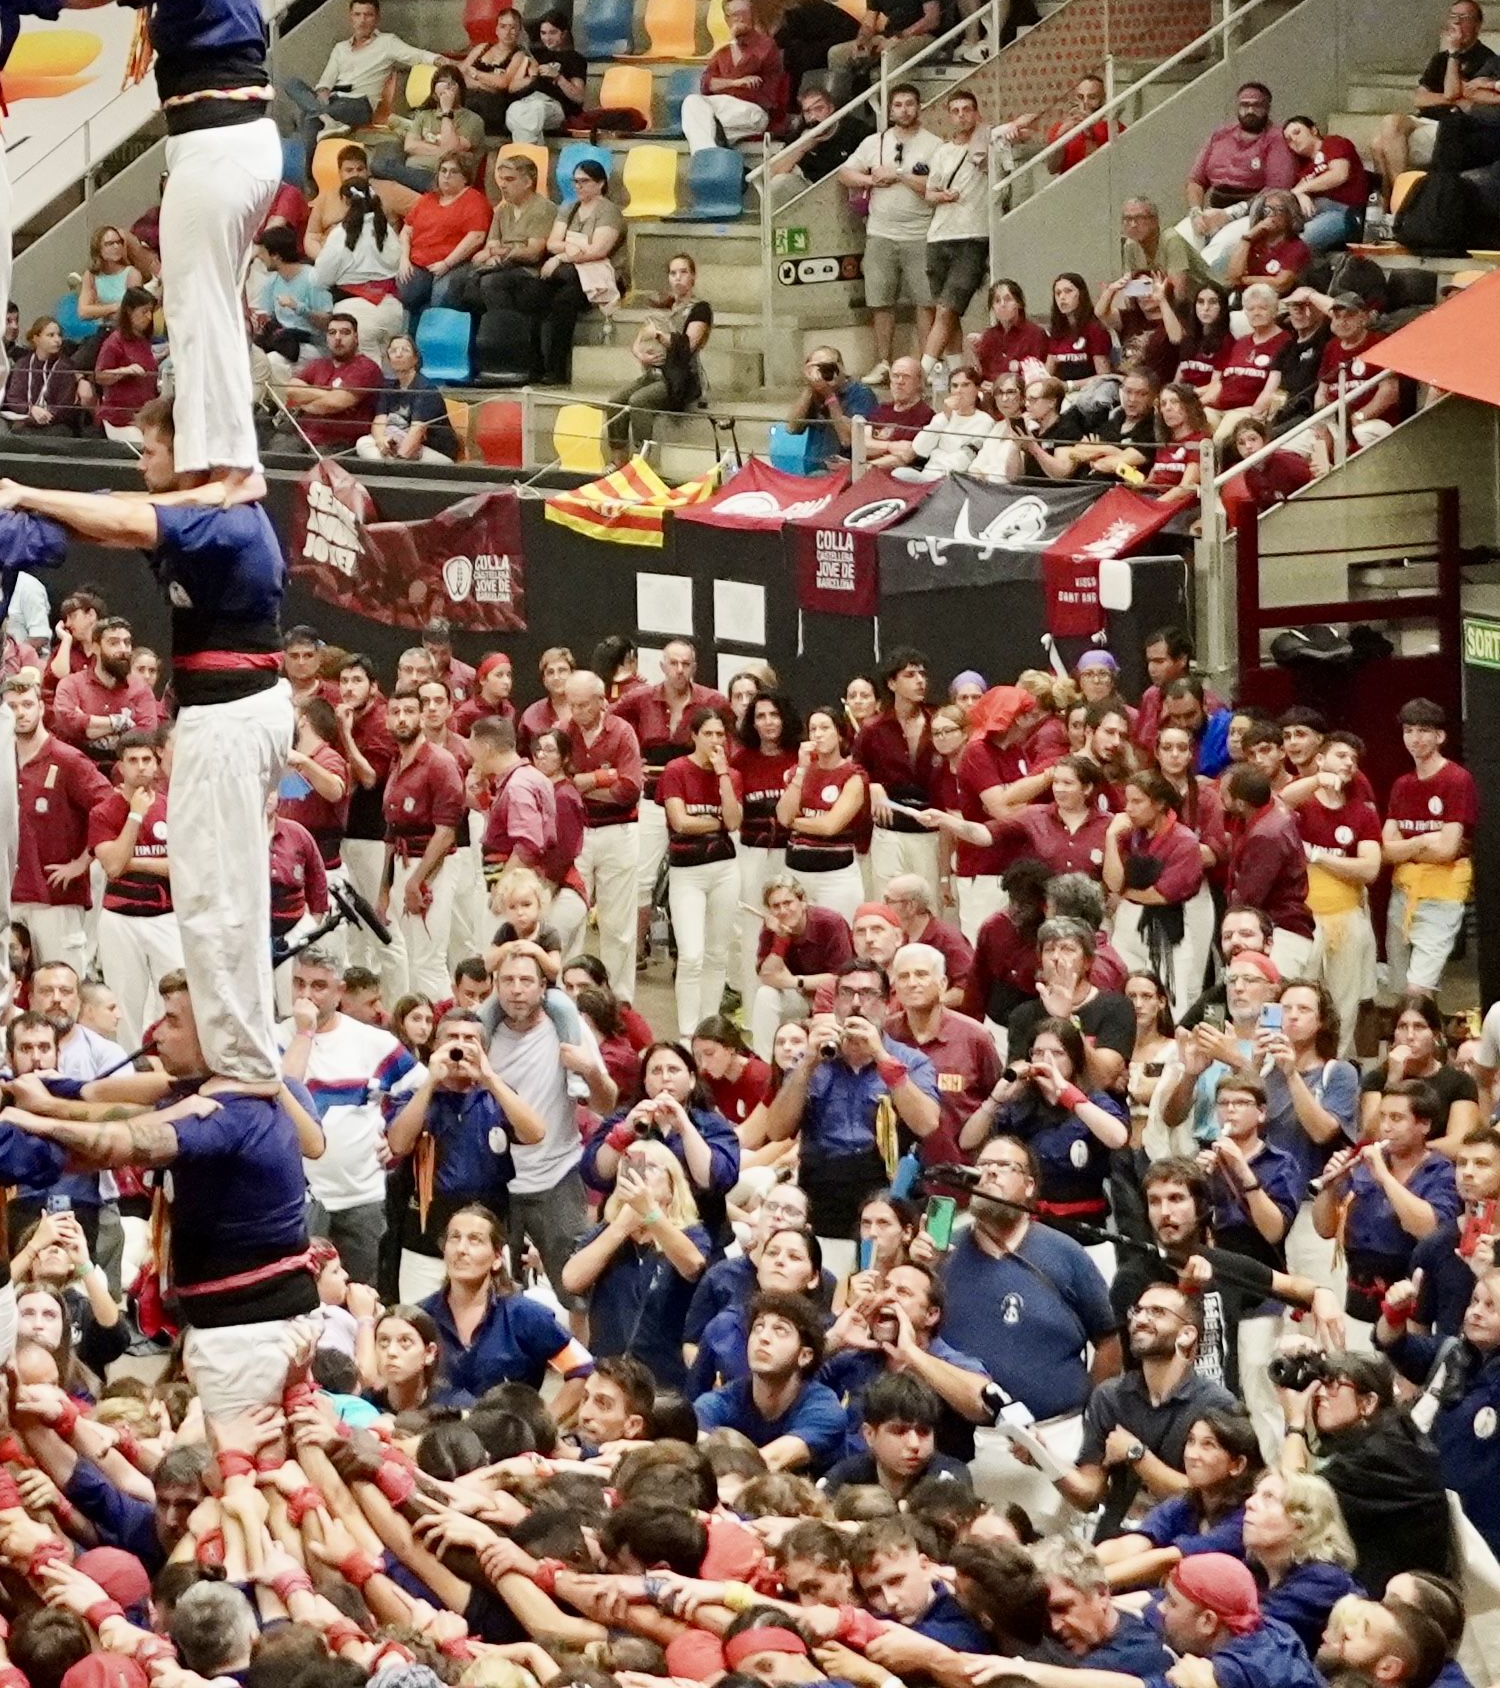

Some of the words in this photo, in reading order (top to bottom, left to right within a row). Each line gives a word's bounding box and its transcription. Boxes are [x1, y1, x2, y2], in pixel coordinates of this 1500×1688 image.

[816, 530, 854, 552] COLLA
[475, 554, 510, 570] COLLA
[816, 562, 840, 578] JOVE
[842, 562, 855, 578] DE
[475, 580, 496, 592] JOVE
[498, 580, 511, 592] DE
